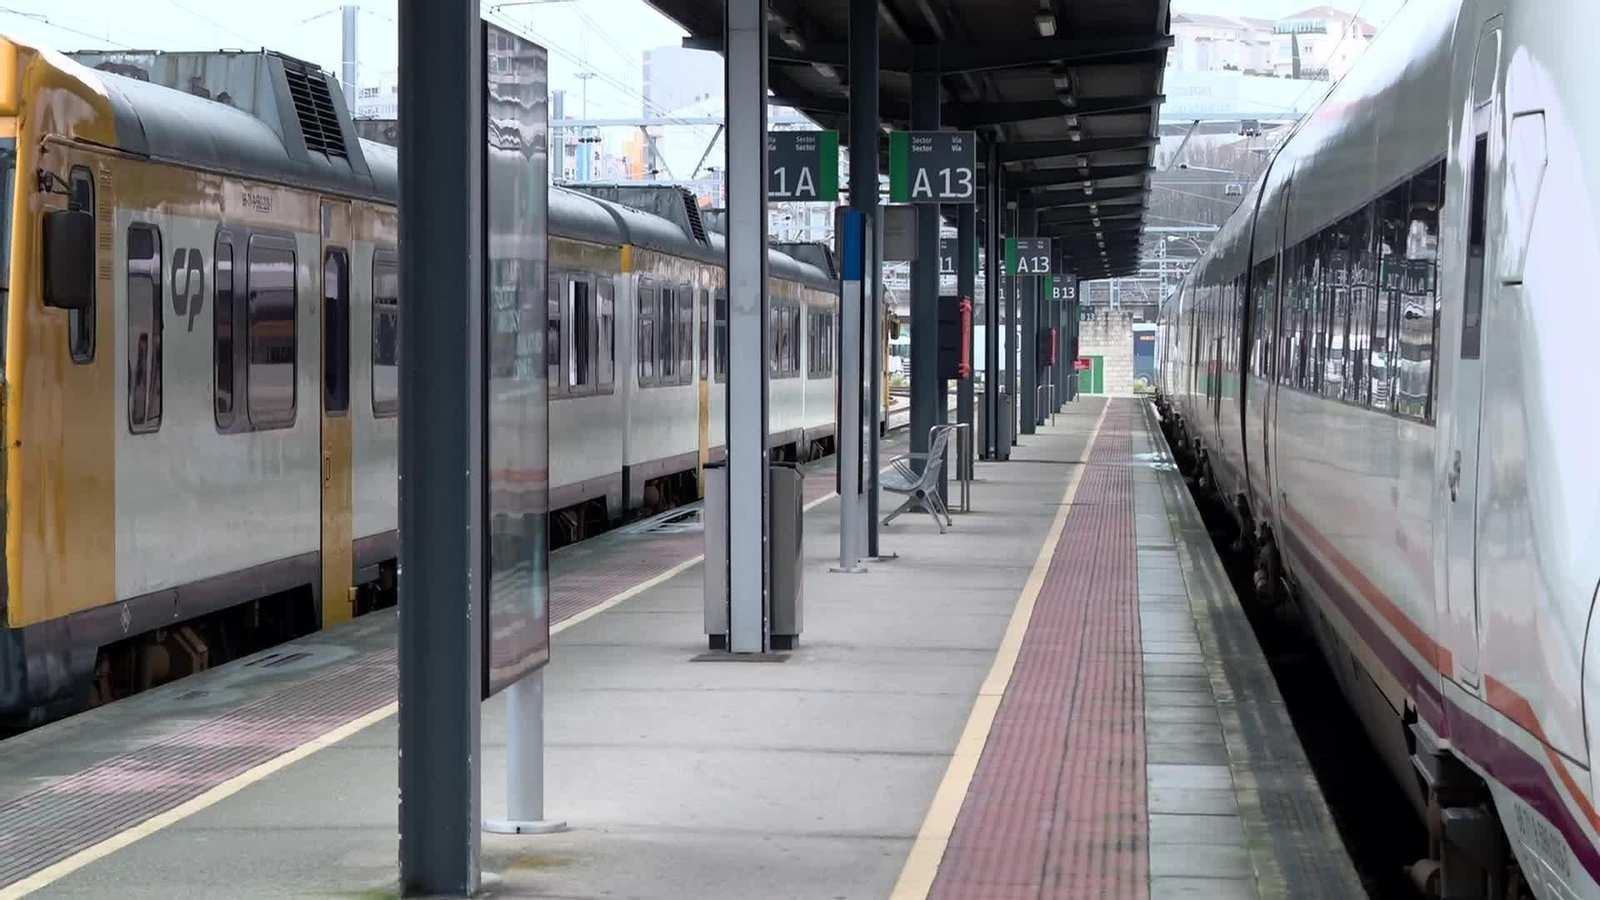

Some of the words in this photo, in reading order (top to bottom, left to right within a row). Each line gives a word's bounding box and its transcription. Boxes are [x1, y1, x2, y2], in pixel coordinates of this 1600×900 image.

[912, 136, 932, 144] Sector
[912, 144, 932, 152] Sector
[795, 167, 816, 196] A
[912, 167, 933, 197] A
[939, 167, 973, 198] 13
[1017, 257, 1029, 273] A
[1031, 256, 1050, 273] 13
[1053, 287, 1060, 299] B
[1062, 287, 1075, 299] 13
[1087, 313, 1095, 321] 13
